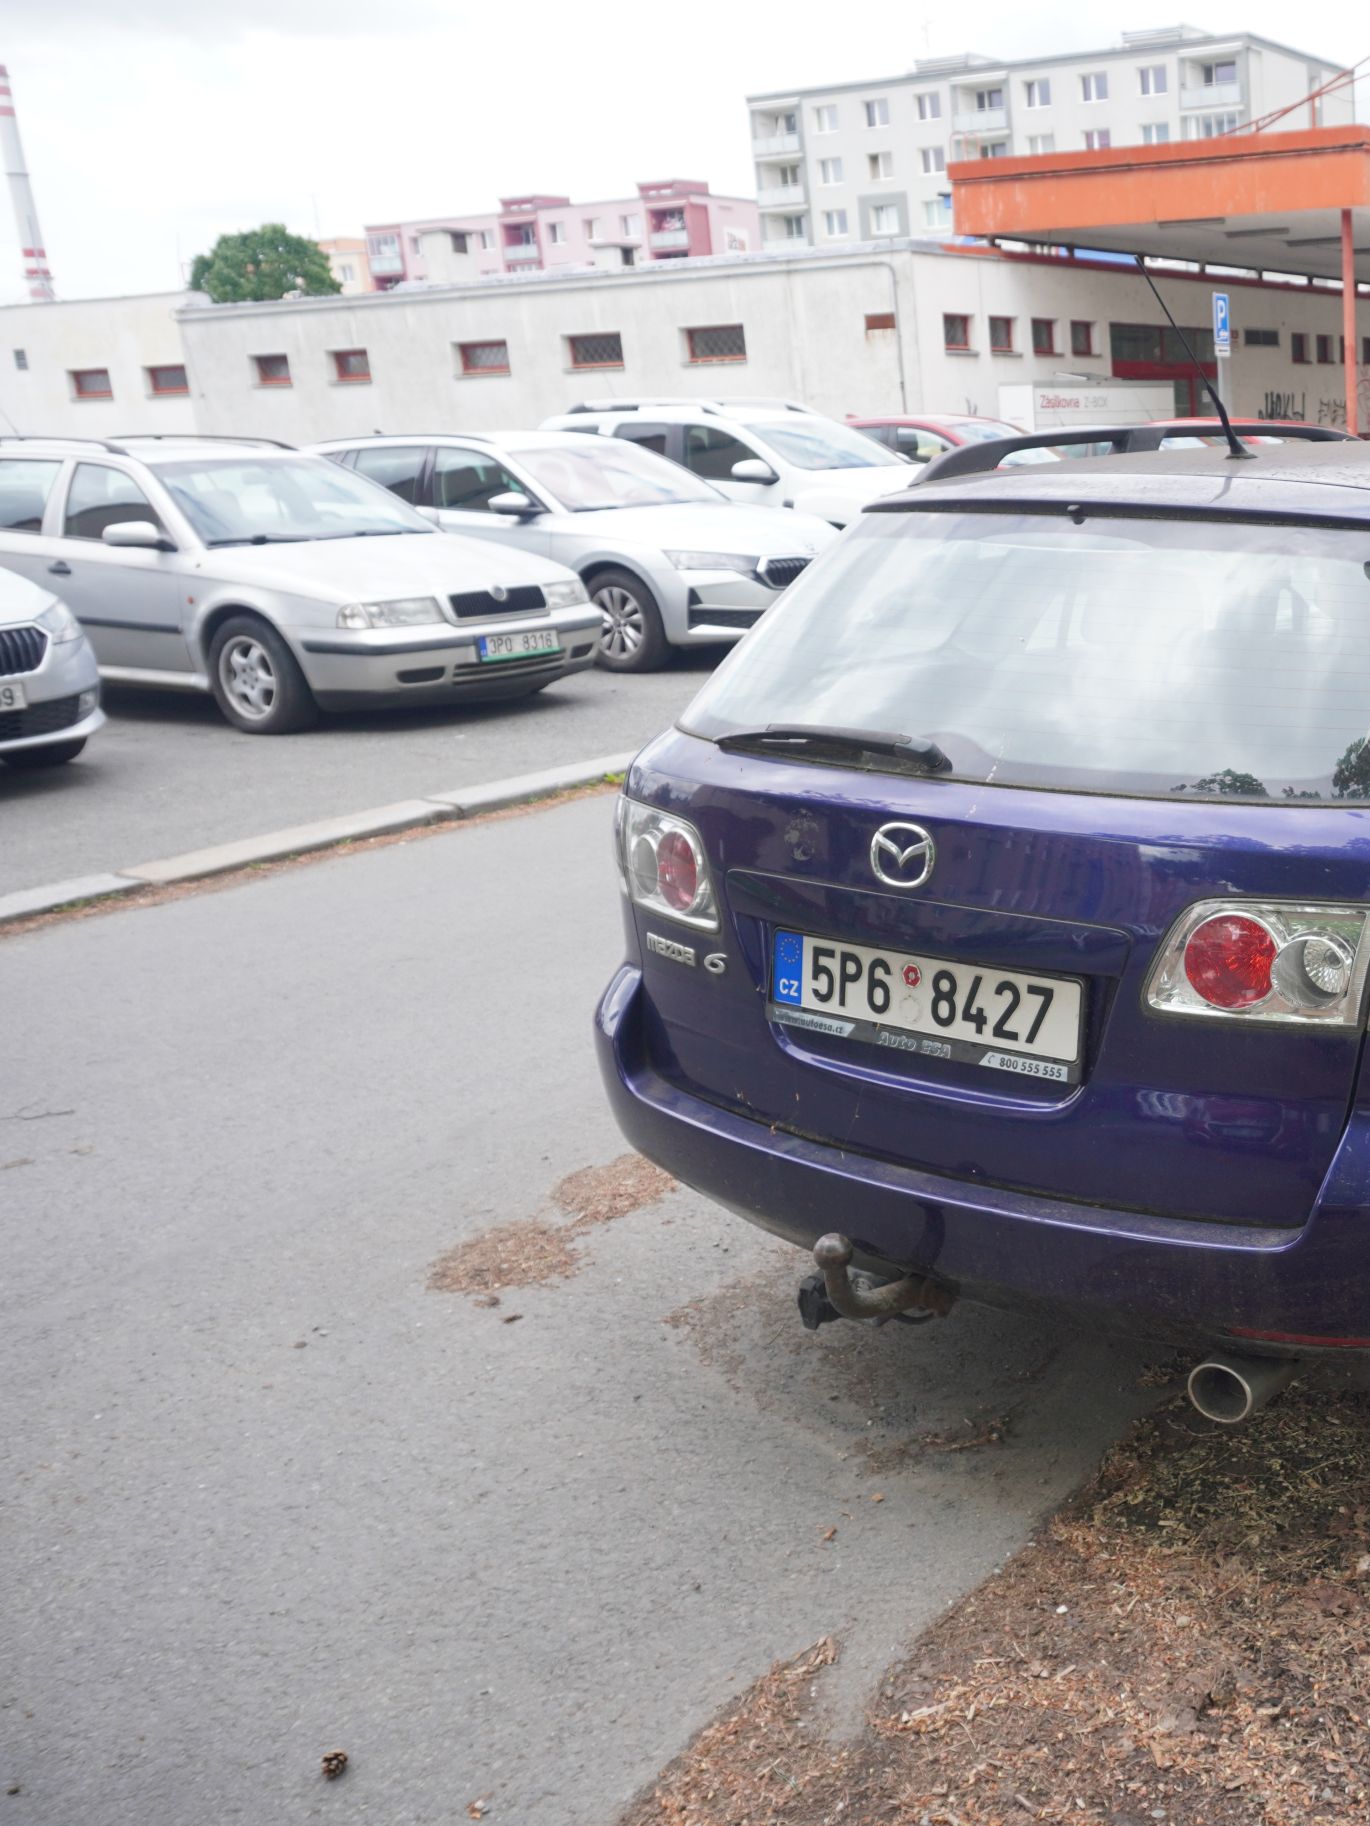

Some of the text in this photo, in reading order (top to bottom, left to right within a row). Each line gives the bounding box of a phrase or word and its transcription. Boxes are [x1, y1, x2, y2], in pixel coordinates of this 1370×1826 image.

[1217, 300, 1225, 329] P
[522, 632, 552, 650] 8316
[703, 953, 728, 975] 6
[779, 978, 799, 997] CZ
[811, 946, 1054, 1044] 5P6 8427
[877, 1031, 952, 1059] Auto ESA
[1000, 1057, 1062, 1078] 800 555 555
